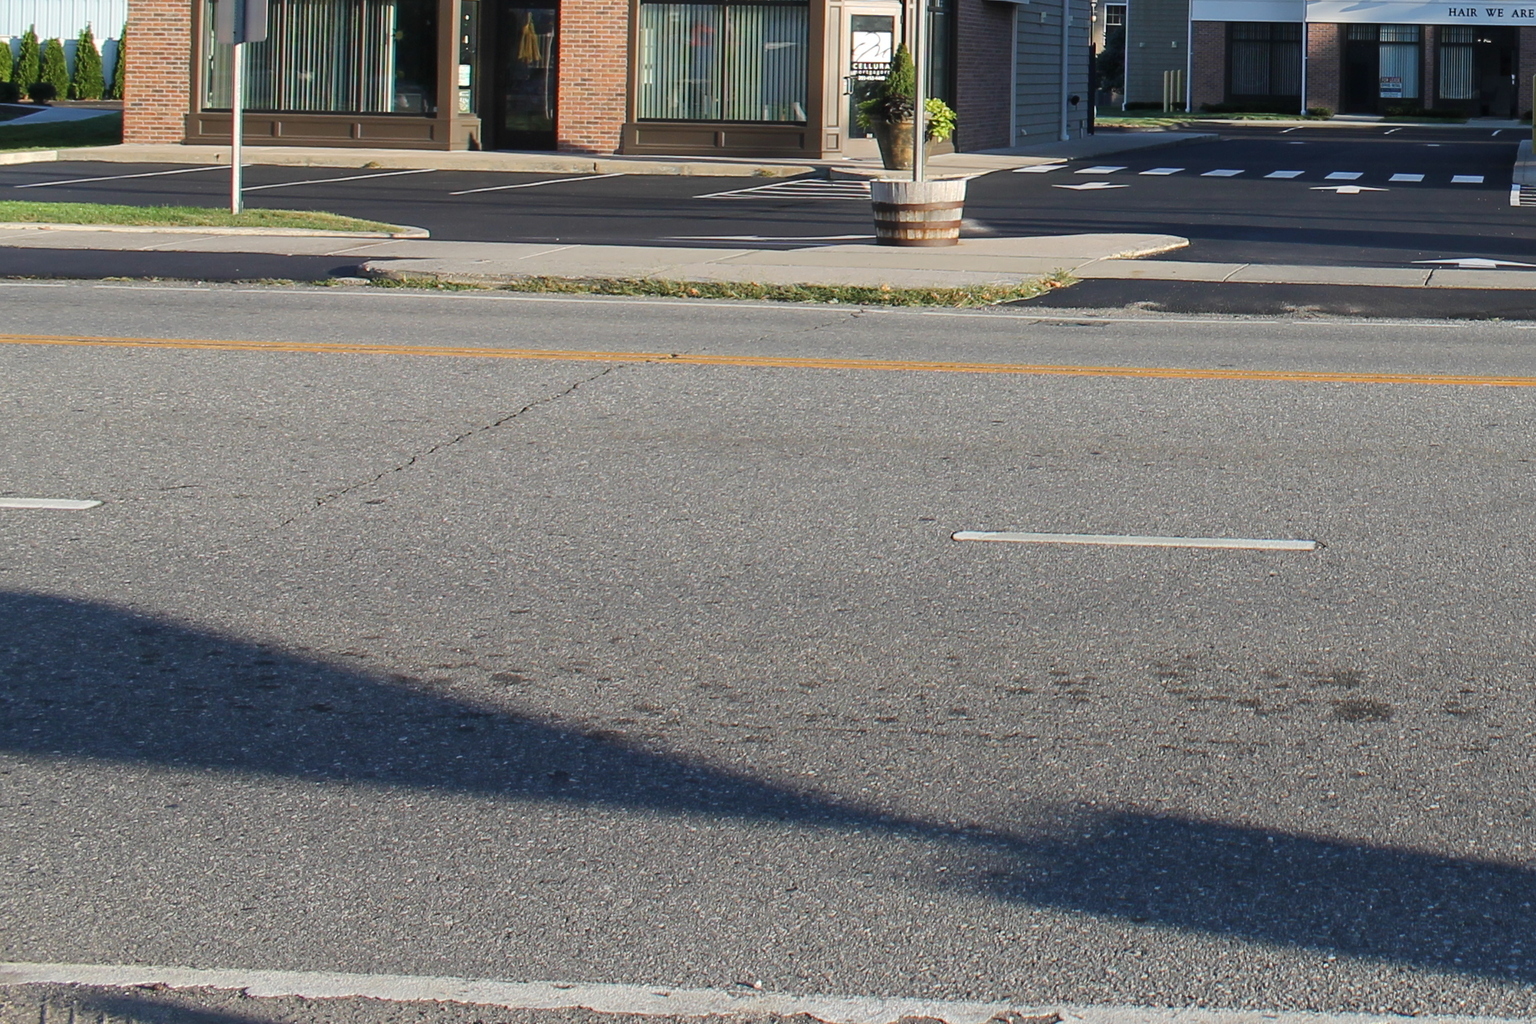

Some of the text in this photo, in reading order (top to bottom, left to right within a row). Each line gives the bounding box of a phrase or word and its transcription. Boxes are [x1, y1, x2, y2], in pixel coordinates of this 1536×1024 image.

[1448, 8, 1534, 18] HAIR WE ARE
